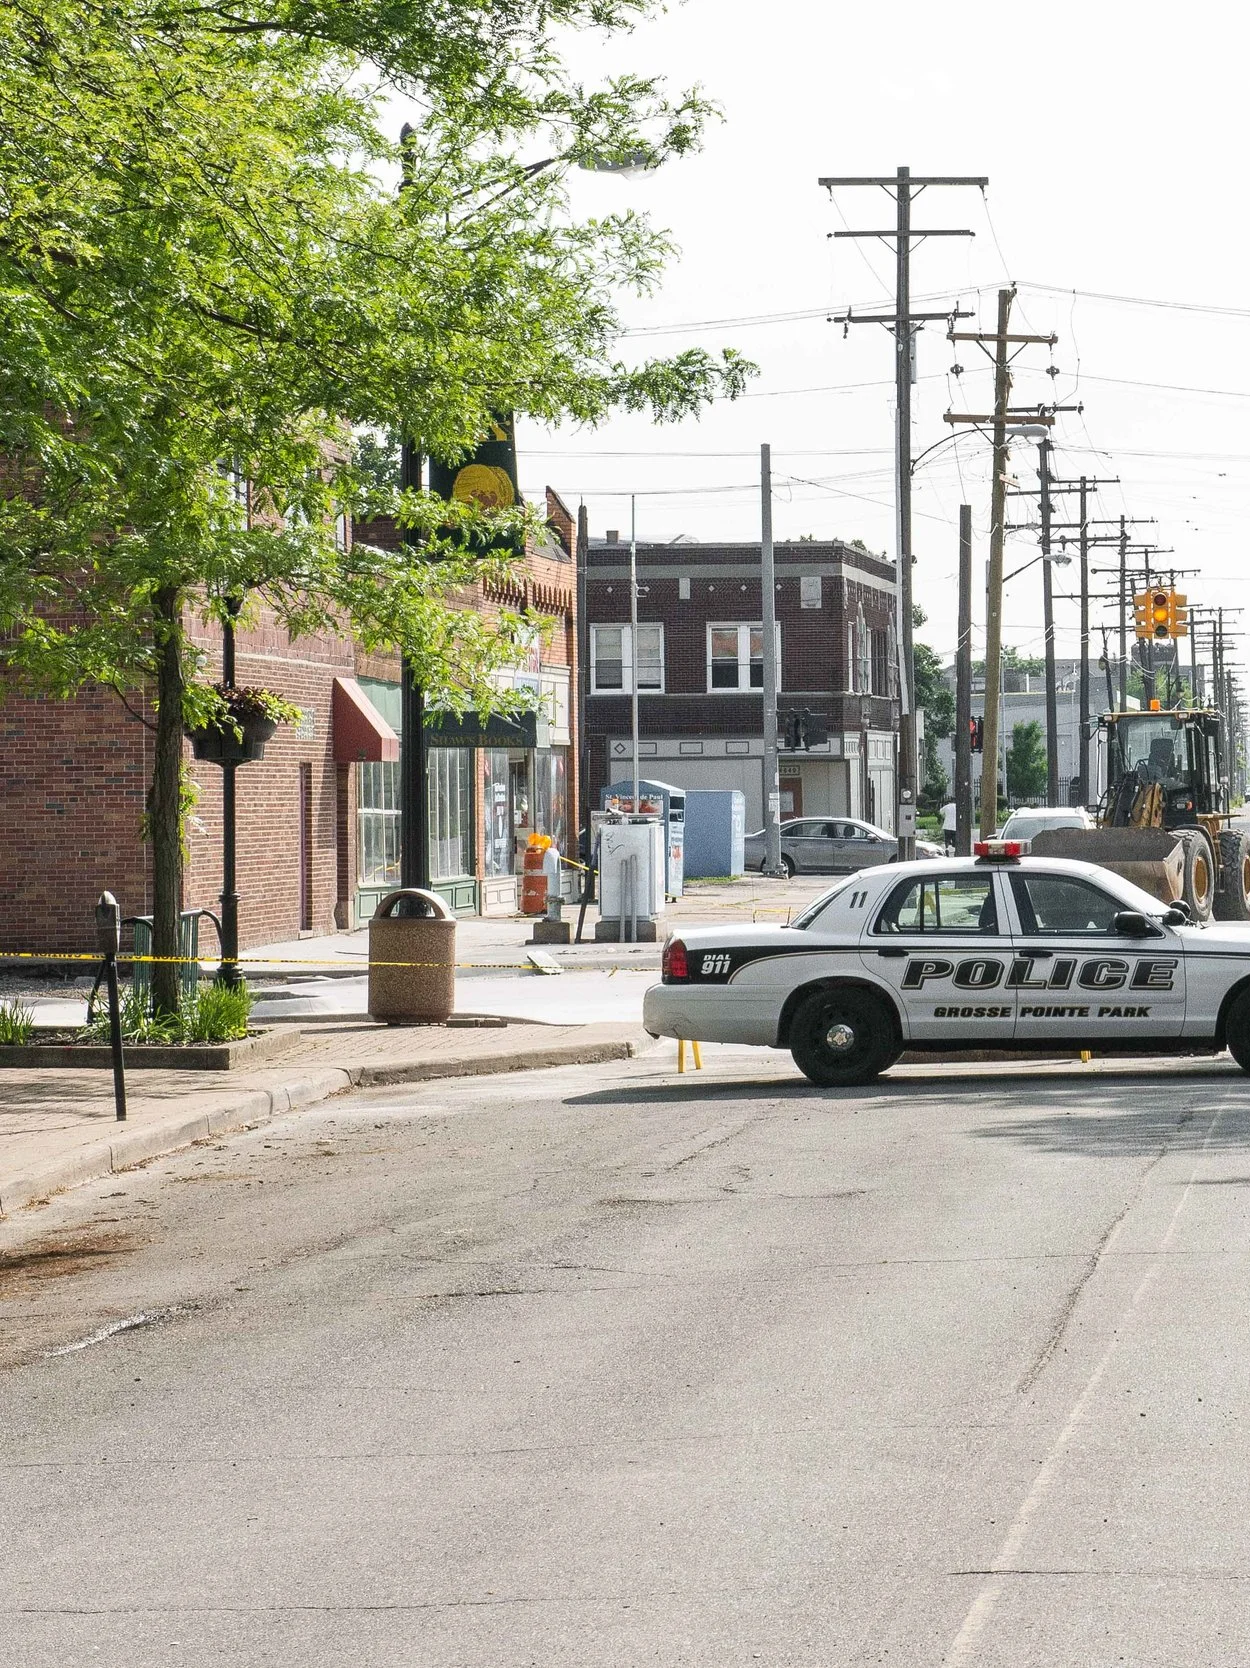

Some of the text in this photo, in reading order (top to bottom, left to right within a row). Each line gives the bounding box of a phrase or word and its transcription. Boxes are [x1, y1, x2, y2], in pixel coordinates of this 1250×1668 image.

[849, 891, 868, 909] 11
[700, 961, 731, 974] 911
[899, 957, 1179, 991] POLICE
[933, 1006, 1152, 1018] GROSSE POINTE PARK
